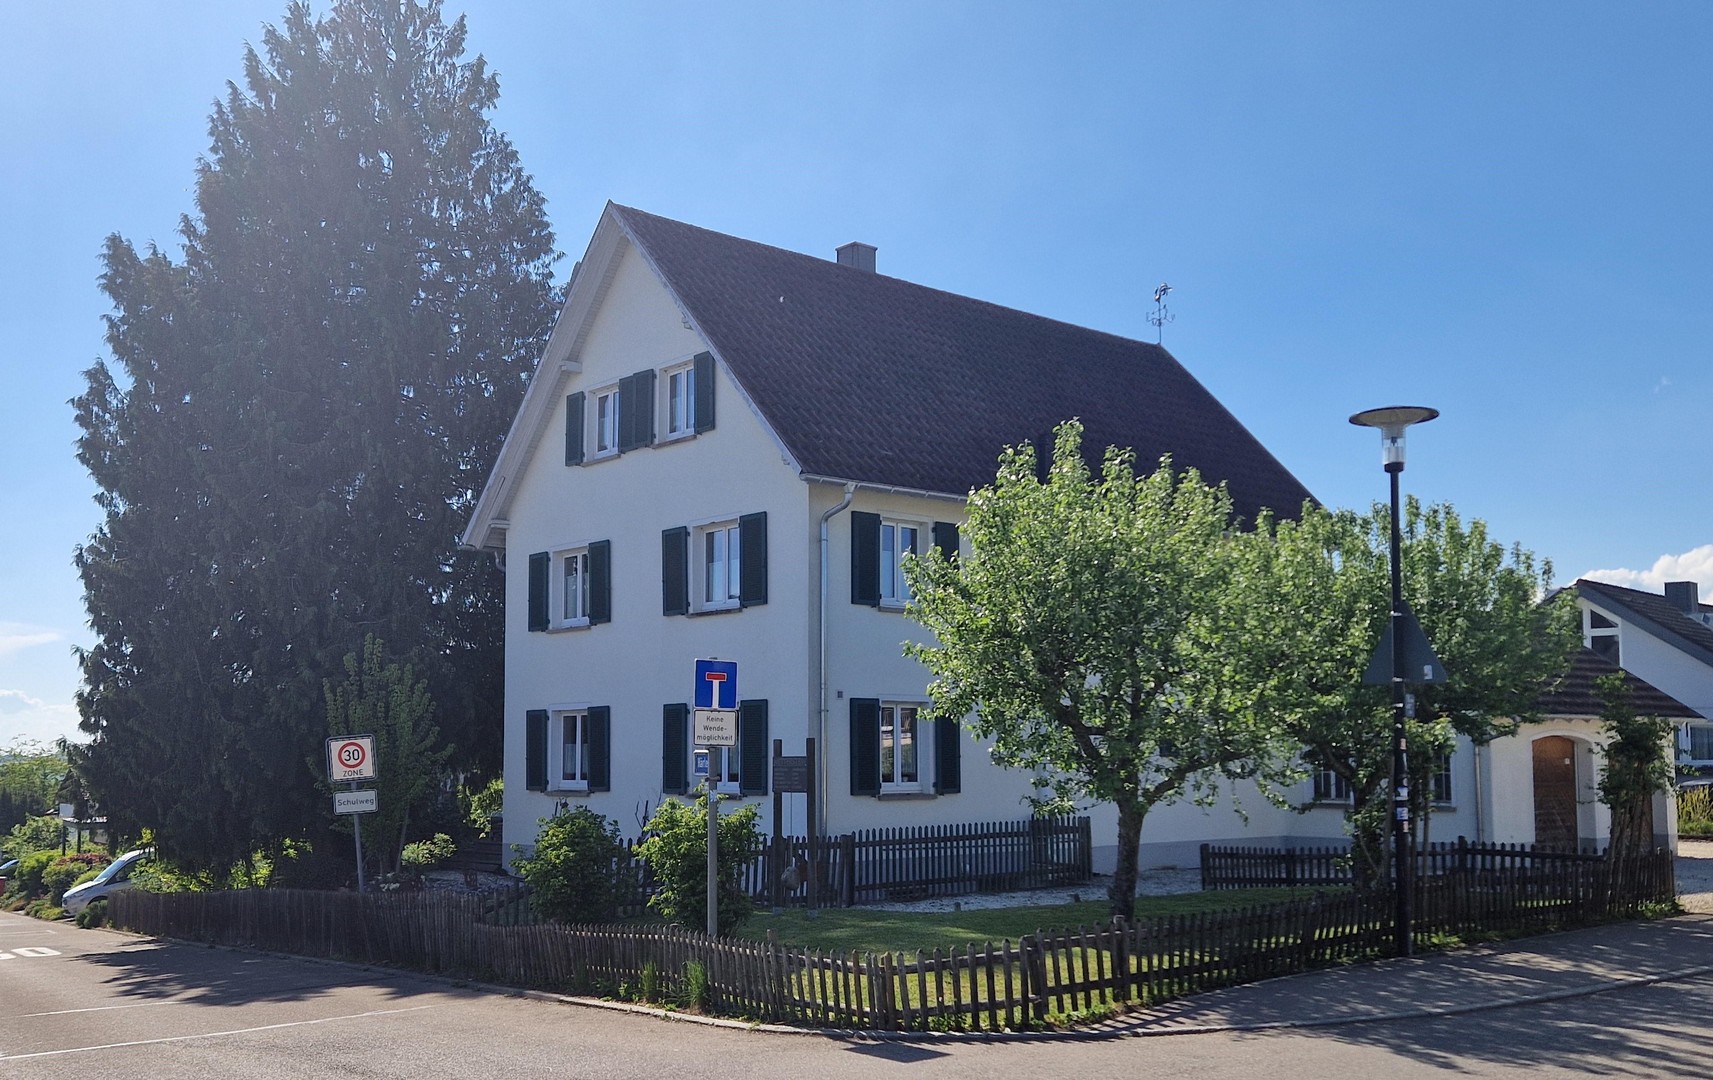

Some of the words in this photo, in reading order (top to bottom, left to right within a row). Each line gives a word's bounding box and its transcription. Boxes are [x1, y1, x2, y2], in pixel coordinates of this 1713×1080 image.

[696, 734, 733, 742] möglichkeit
[343, 749, 360, 761] 30
[343, 769, 364, 777] ZONE
[337, 798, 374, 806] Schulweg
